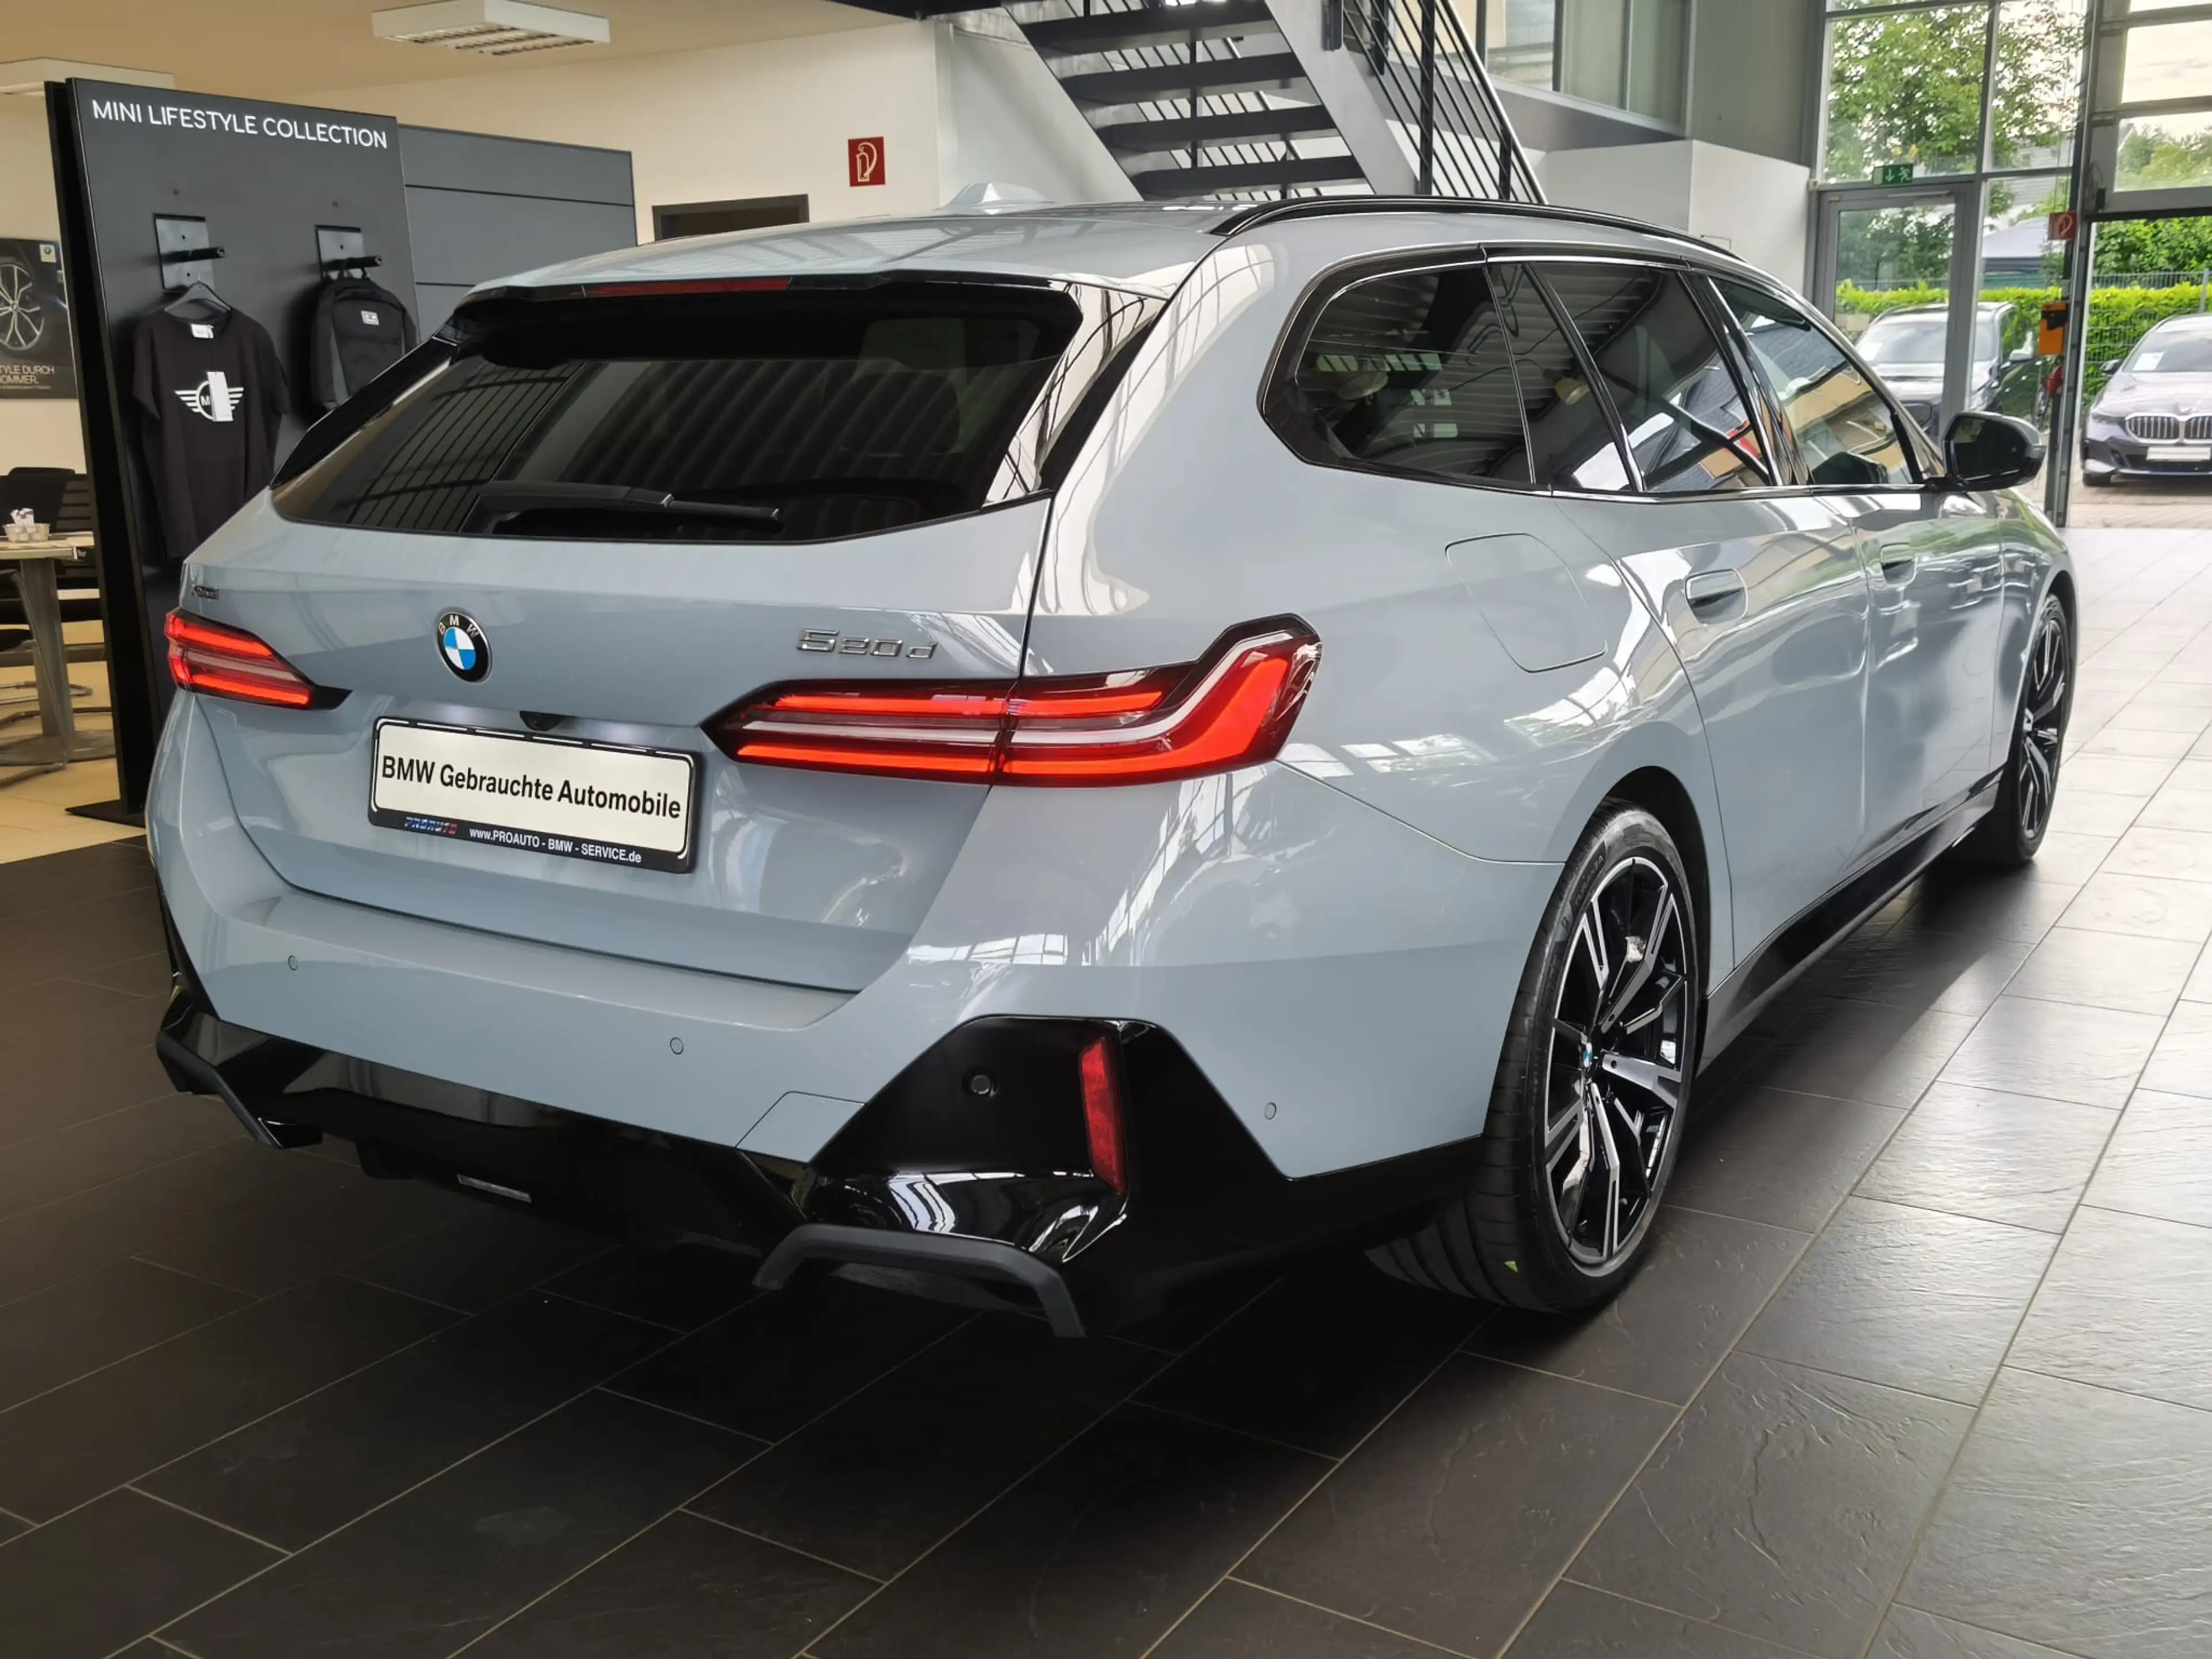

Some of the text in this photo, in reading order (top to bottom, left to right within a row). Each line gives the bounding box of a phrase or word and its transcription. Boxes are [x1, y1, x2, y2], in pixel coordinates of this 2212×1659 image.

[92, 99, 388, 149] MINI LIFESTYLE COLLECTION
[22, 365, 55, 376] DURCH
[438, 615, 479, 638] BMW
[382, 755, 681, 819] BMW Gebrauchte Automobile
[469, 827, 540, 849] www.PROAUTO
[548, 839, 573, 853] BMW
[581, 843, 642, 863] SERVICE.de
